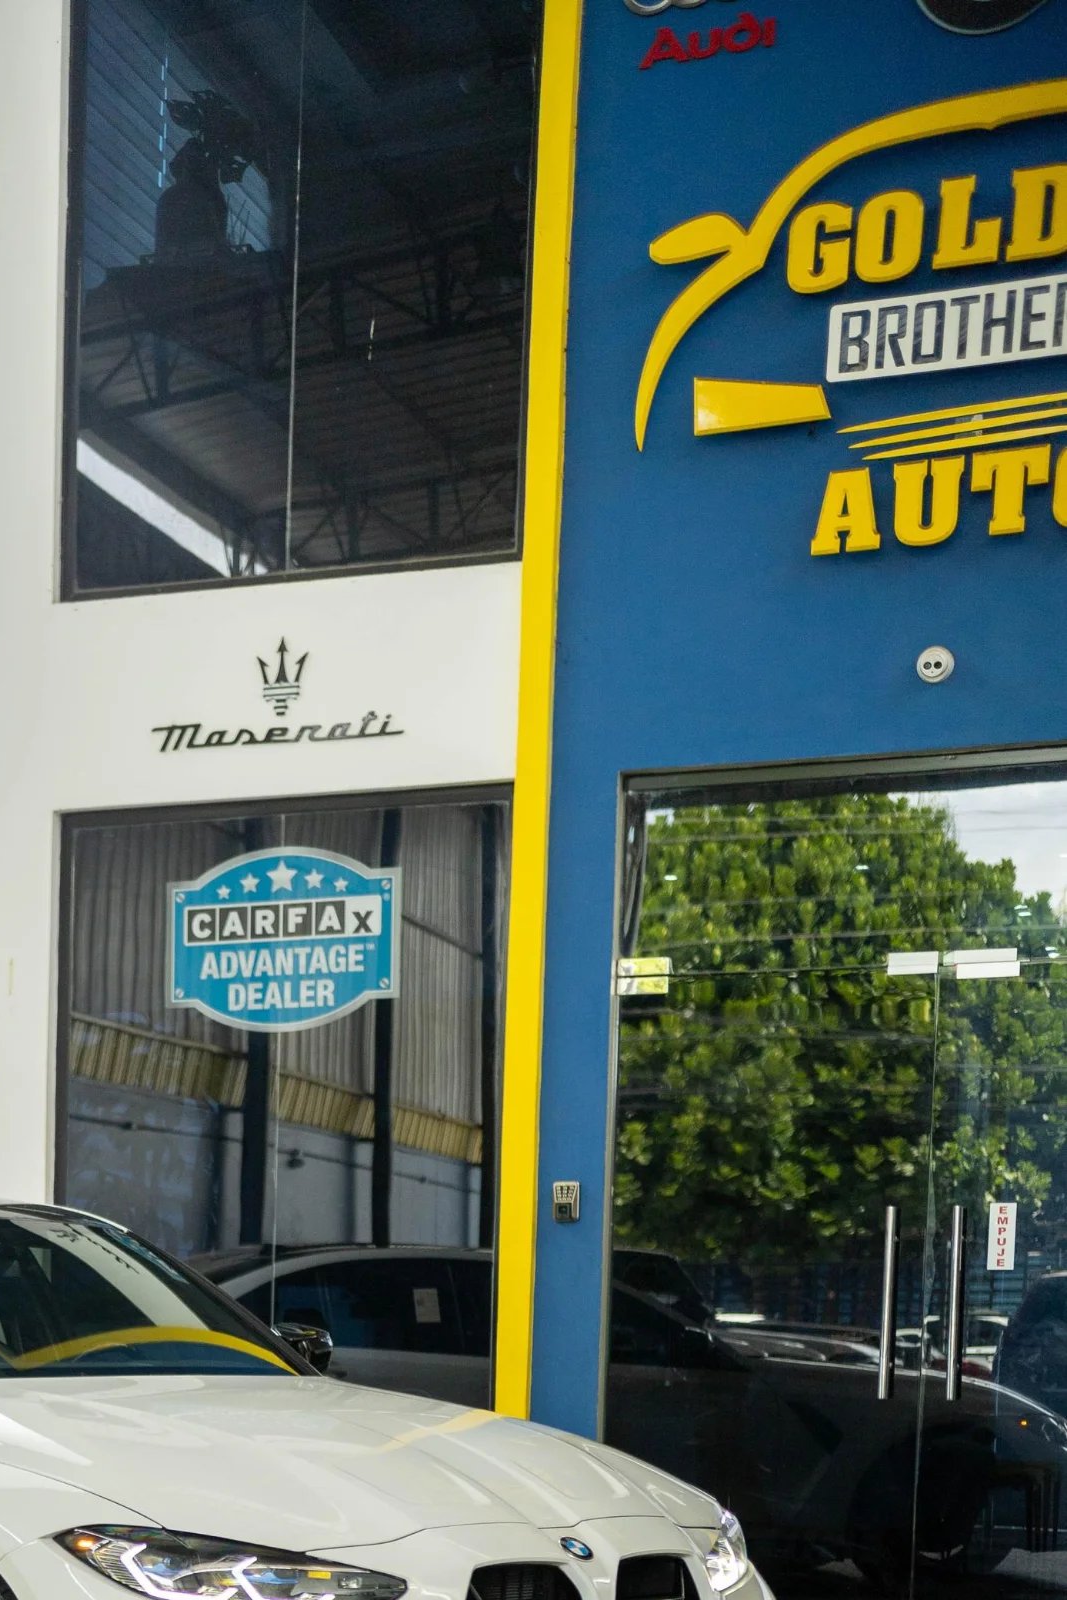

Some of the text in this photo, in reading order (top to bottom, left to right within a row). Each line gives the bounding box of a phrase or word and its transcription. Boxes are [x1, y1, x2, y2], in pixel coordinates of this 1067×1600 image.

[640, 12, 777, 69] Audi
[810, 443, 1067, 556] AUT
[151, 711, 404, 753] Maserati
[189, 902, 374, 942] CARFAX
[227, 982, 335, 1012] DEALER
[996, 1205, 1009, 1268] EMPUJE
